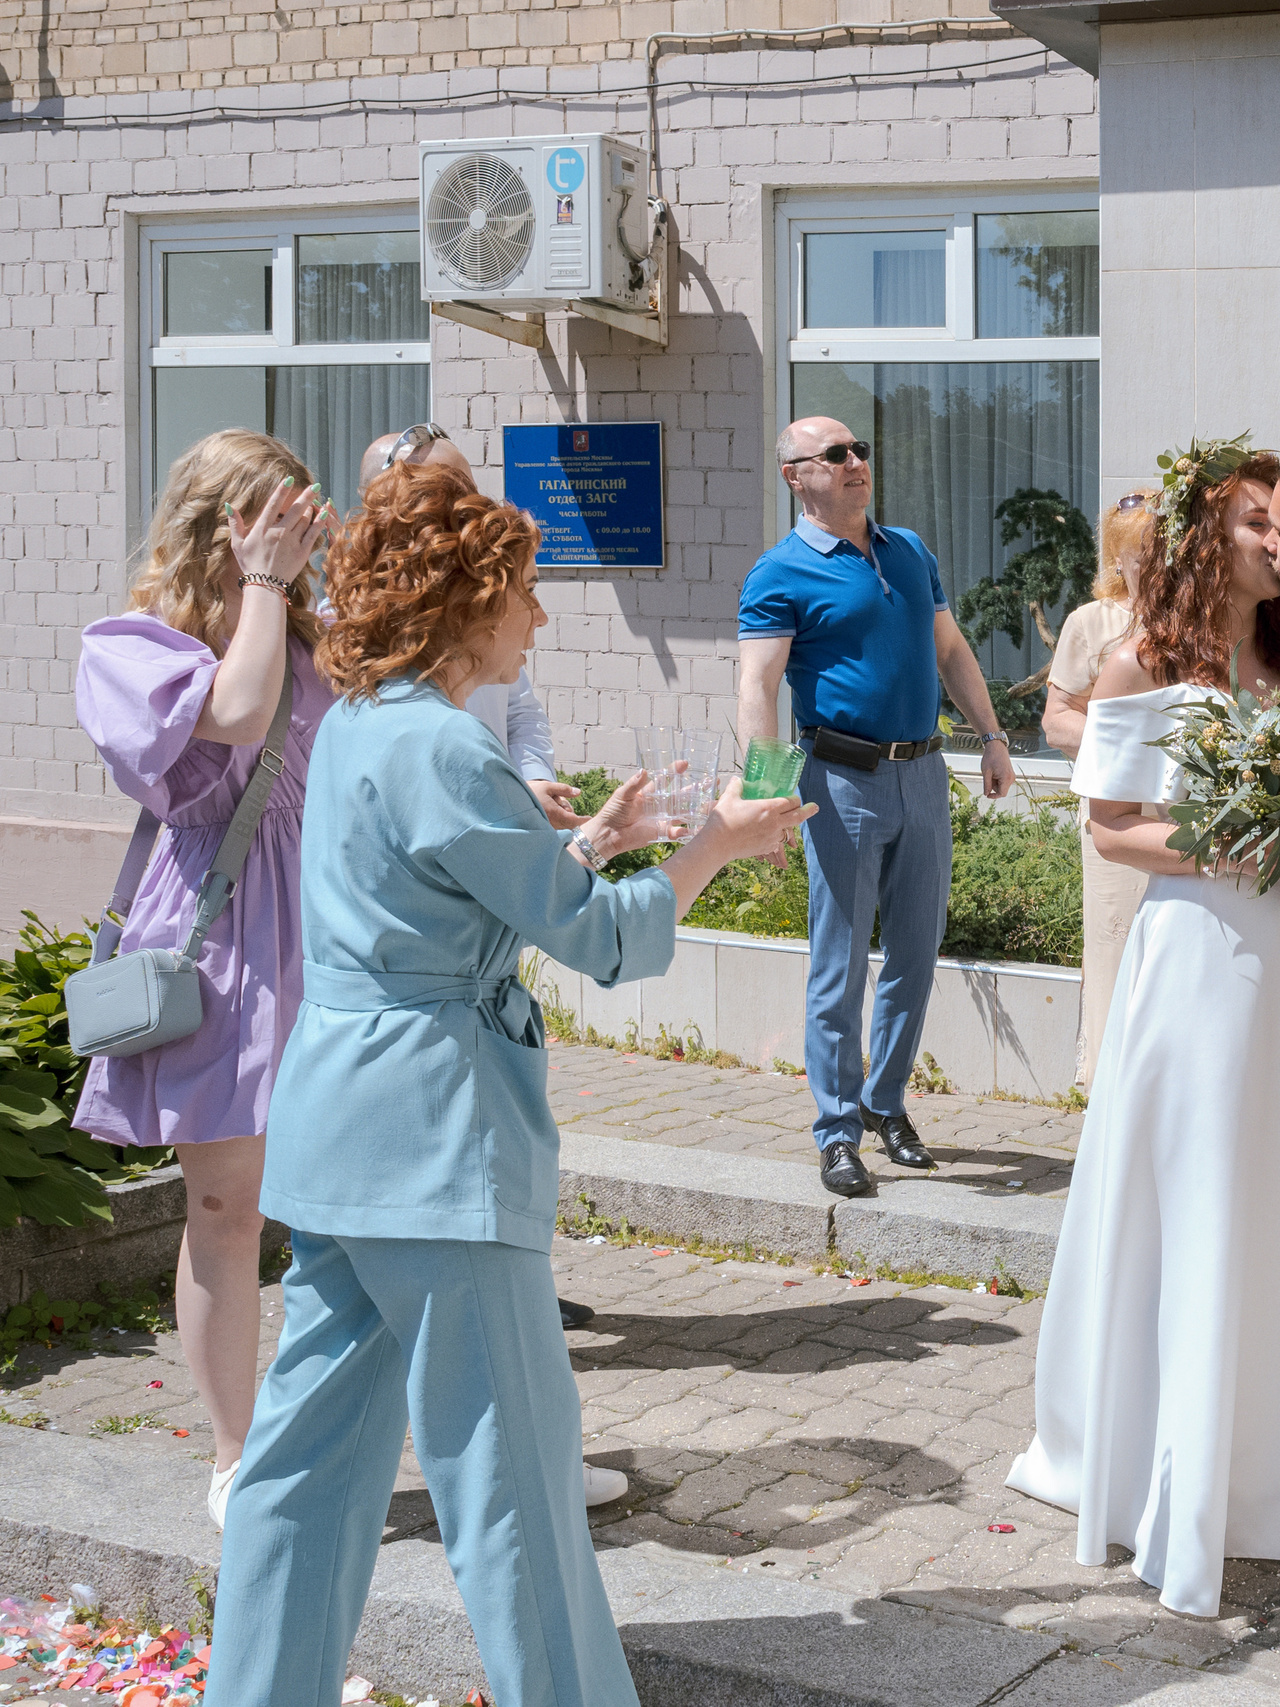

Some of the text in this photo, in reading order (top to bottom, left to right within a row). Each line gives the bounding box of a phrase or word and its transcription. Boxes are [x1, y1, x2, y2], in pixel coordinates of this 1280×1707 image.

[539, 478, 626, 490] ГАГАРИНСКИЙ
[548, 493, 617, 505] отдел ЗАГС
